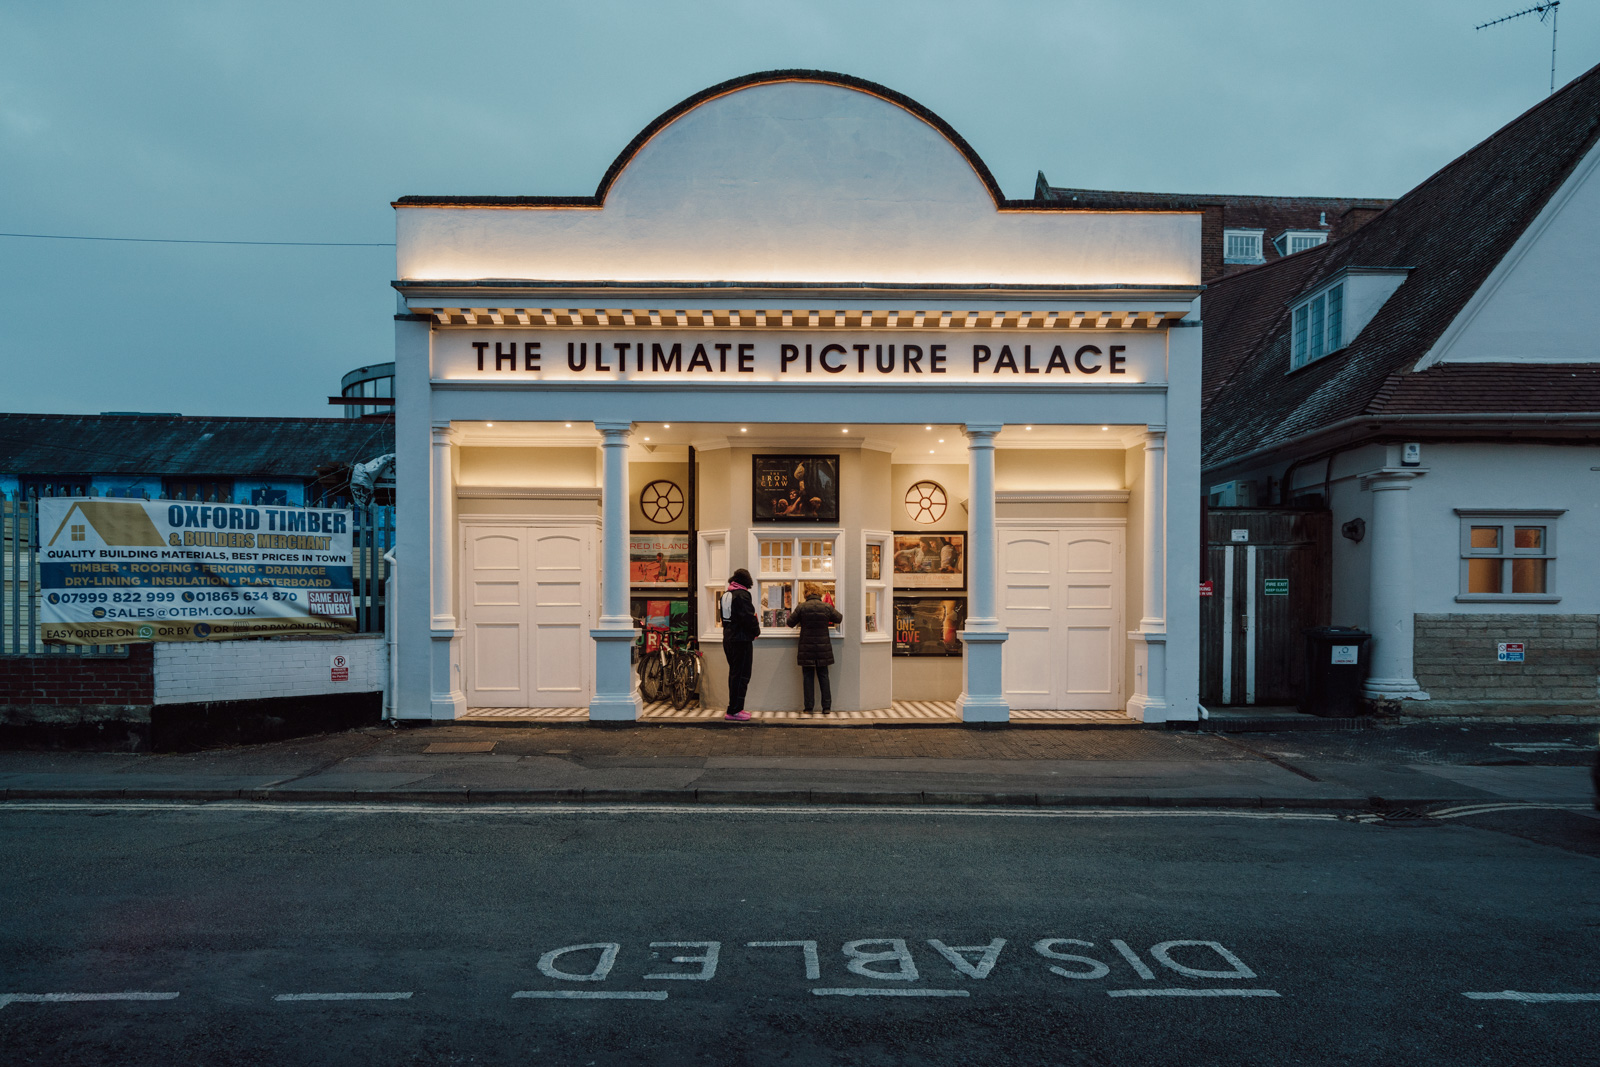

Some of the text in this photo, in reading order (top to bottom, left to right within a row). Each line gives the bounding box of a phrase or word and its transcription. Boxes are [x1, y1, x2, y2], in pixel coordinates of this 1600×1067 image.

[472, 342, 1126, 374] THE ULTIMATE PICTURE PALACE
[168, 505, 346, 533] OXFORD TIMBER
[169, 531, 332, 550] & BUILDERS MERCHANT
[48, 550, 96, 558] QUALITY
[100, 550, 158, 558] BUILDING
[162, 550, 229, 561] MATERIALS,
[232, 552, 259, 560] BEST
[262, 554, 299, 562] PRICES
[316, 554, 346, 562] TOWN
[70, 564, 326, 576] TIMBER ROOFING FENCING DRAINAGE
[64, 576, 332, 587] DRY-LINING INSULATION PLASTERBOARD
[62, 592, 298, 603] 07999 822 999 01865 634 870
[310, 592, 350, 603] SAME DAY
[108, 606, 256, 618] SALES@OTBM.CO.UK
[310, 603, 350, 615] DELIVERY
[47, 630, 74, 638] EASY
[76, 628, 114, 638] ORDER
[116, 628, 134, 636] ON
[158, 627, 174, 636] OR
[177, 627, 191, 635] BY
[214, 624, 229, 632] OR
[306, 622, 350, 630] DELIVERY
[896, 618, 915, 631] ONE
[896, 631, 920, 642] LOVE
[537, 938, 1257, 981] DISABLED
